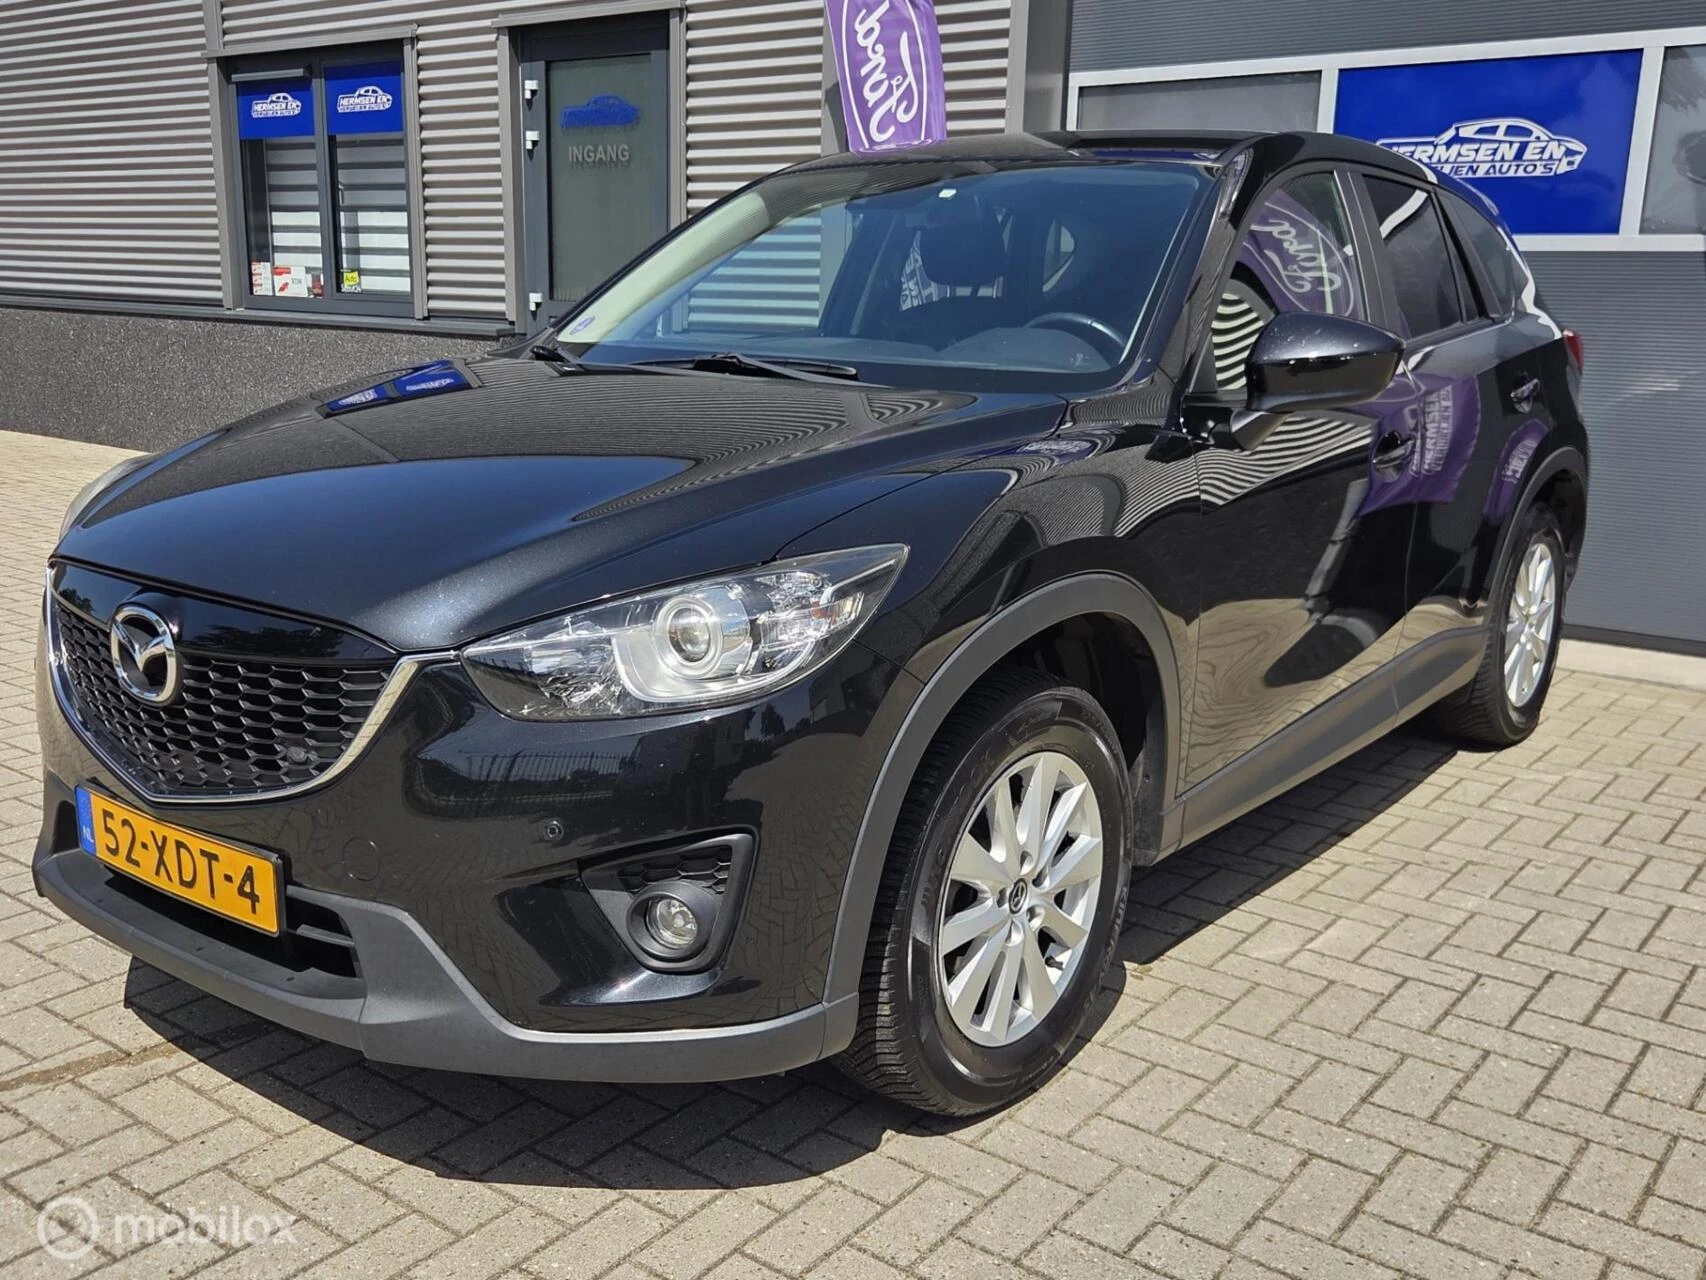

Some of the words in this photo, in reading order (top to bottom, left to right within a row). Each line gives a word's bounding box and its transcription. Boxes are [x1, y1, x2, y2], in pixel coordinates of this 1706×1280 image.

[568, 144, 630, 162] INGANG
[1391, 142, 1520, 163] ERMSEN
[1522, 141, 1566, 160] EN
[1484, 161, 1556, 176] AUTO'S
[82, 826, 95, 844] NL
[102, 808, 260, 915] 52-XDT-4
